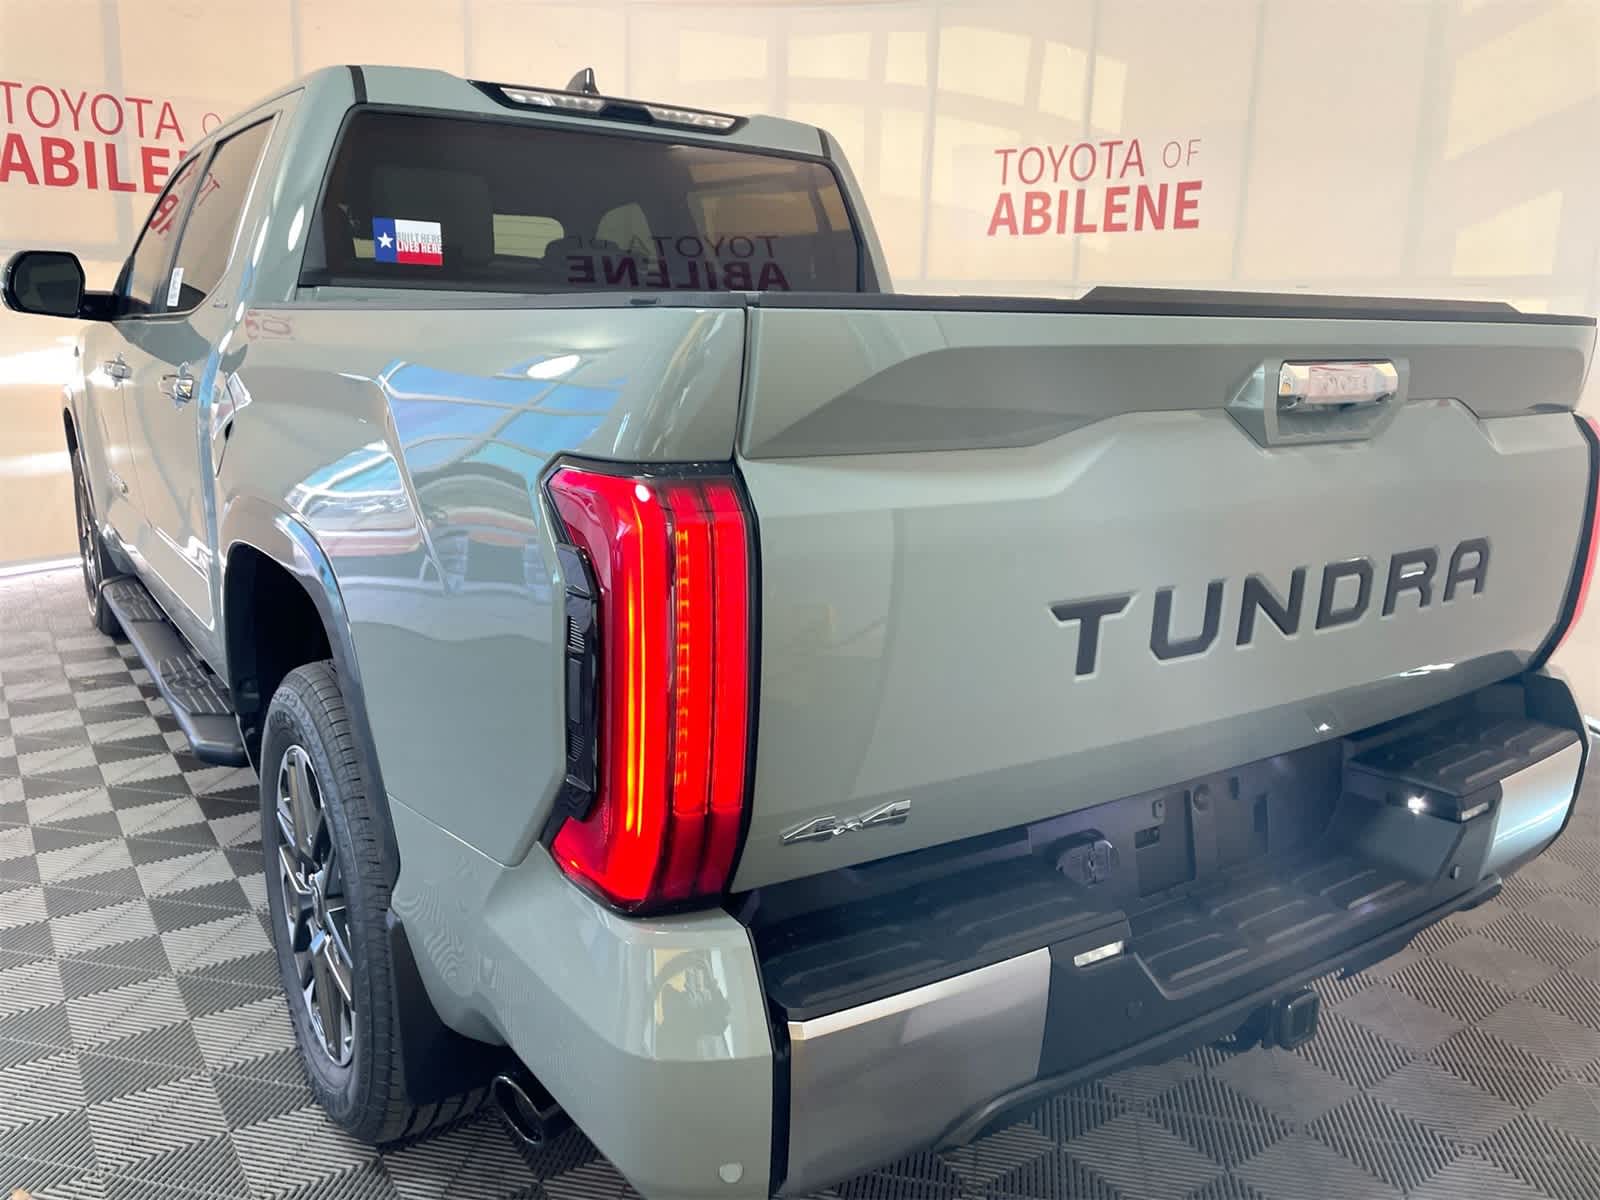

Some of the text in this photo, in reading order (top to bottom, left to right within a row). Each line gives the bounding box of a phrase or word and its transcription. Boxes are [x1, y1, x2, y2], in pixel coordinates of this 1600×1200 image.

[0, 81, 184, 143] TOYOTA
[0, 132, 188, 195] ABILE
[994, 138, 1201, 186] TOYOTA OF
[987, 180, 1203, 236] ABILENE
[396, 240, 443, 255] LIVES HERE
[1049, 536, 1491, 677] TUNDRA
